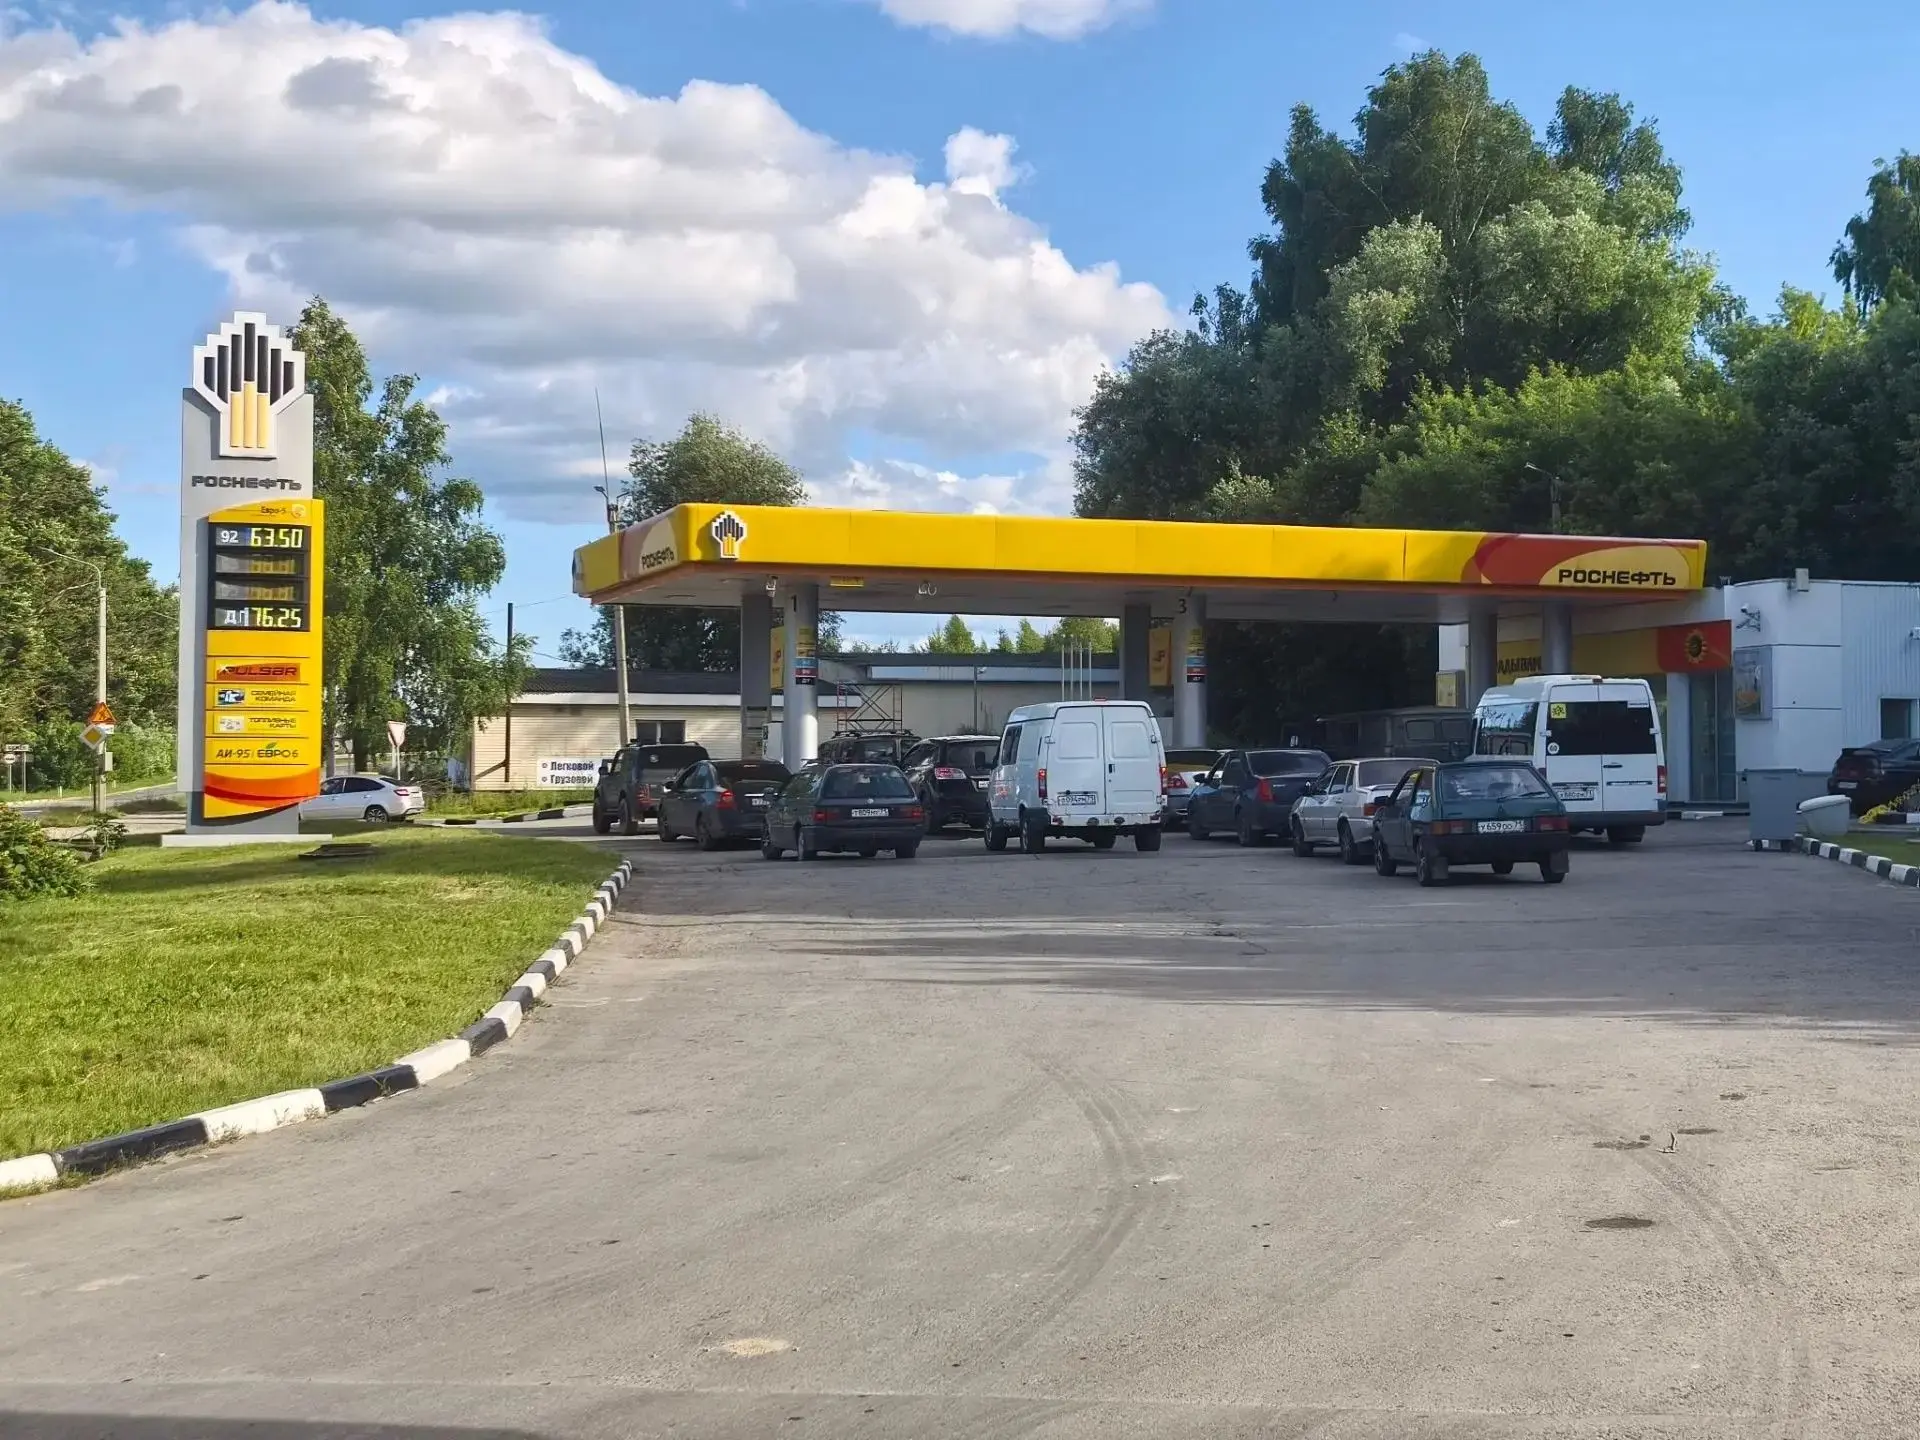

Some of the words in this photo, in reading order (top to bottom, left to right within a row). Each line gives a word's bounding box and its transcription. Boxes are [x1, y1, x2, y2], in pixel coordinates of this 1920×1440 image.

[191, 475, 302, 491] РОСНЕФТЬ
[220, 530, 239, 544] 92
[250, 527, 303, 549] 63.50
[1558, 569, 1677, 586] РОСНЕФТЬ
[1178, 598, 1188, 614] 3
[251, 606, 302, 628] 76.25
[550, 760, 594, 771] Легковой
